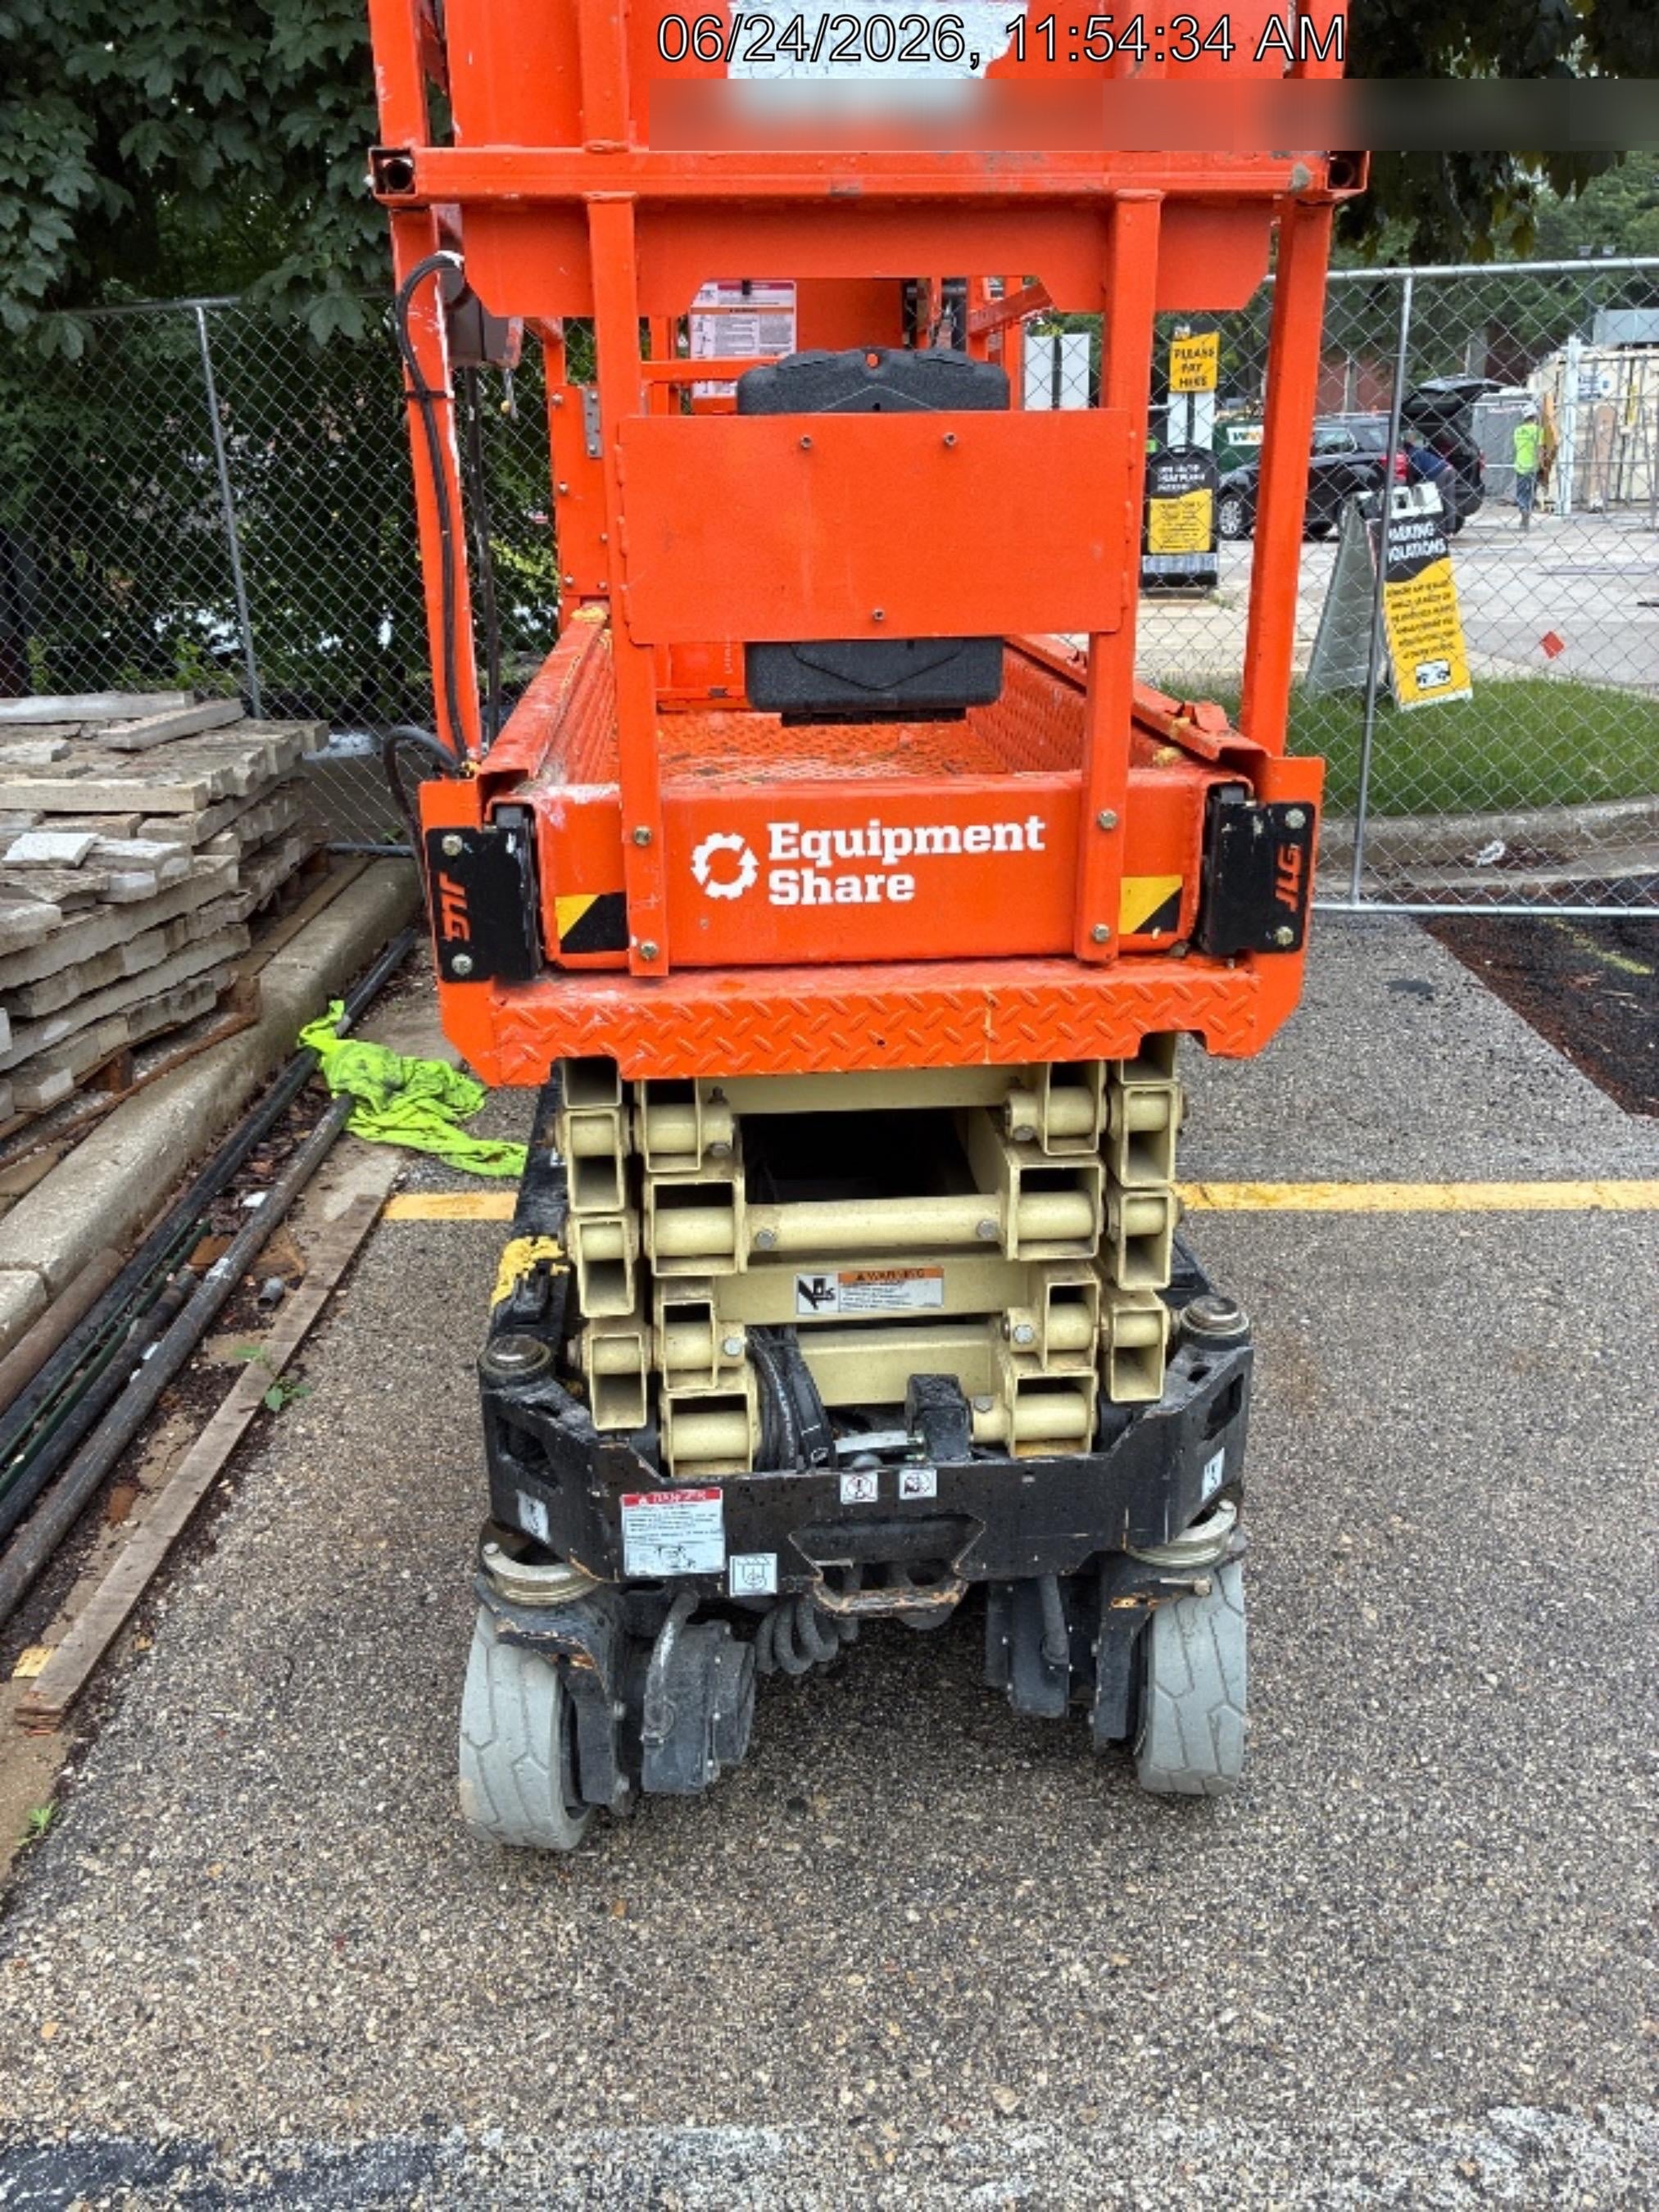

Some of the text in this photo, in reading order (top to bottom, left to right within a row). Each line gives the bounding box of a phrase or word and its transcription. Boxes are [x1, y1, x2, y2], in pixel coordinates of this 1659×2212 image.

[767, 814, 1046, 868] Equipment
[768, 868, 915, 905] Share
[1275, 843, 1303, 913] JLG
[439, 872, 470, 942] JLG
[868, 1268, 926, 1281] WARNING
